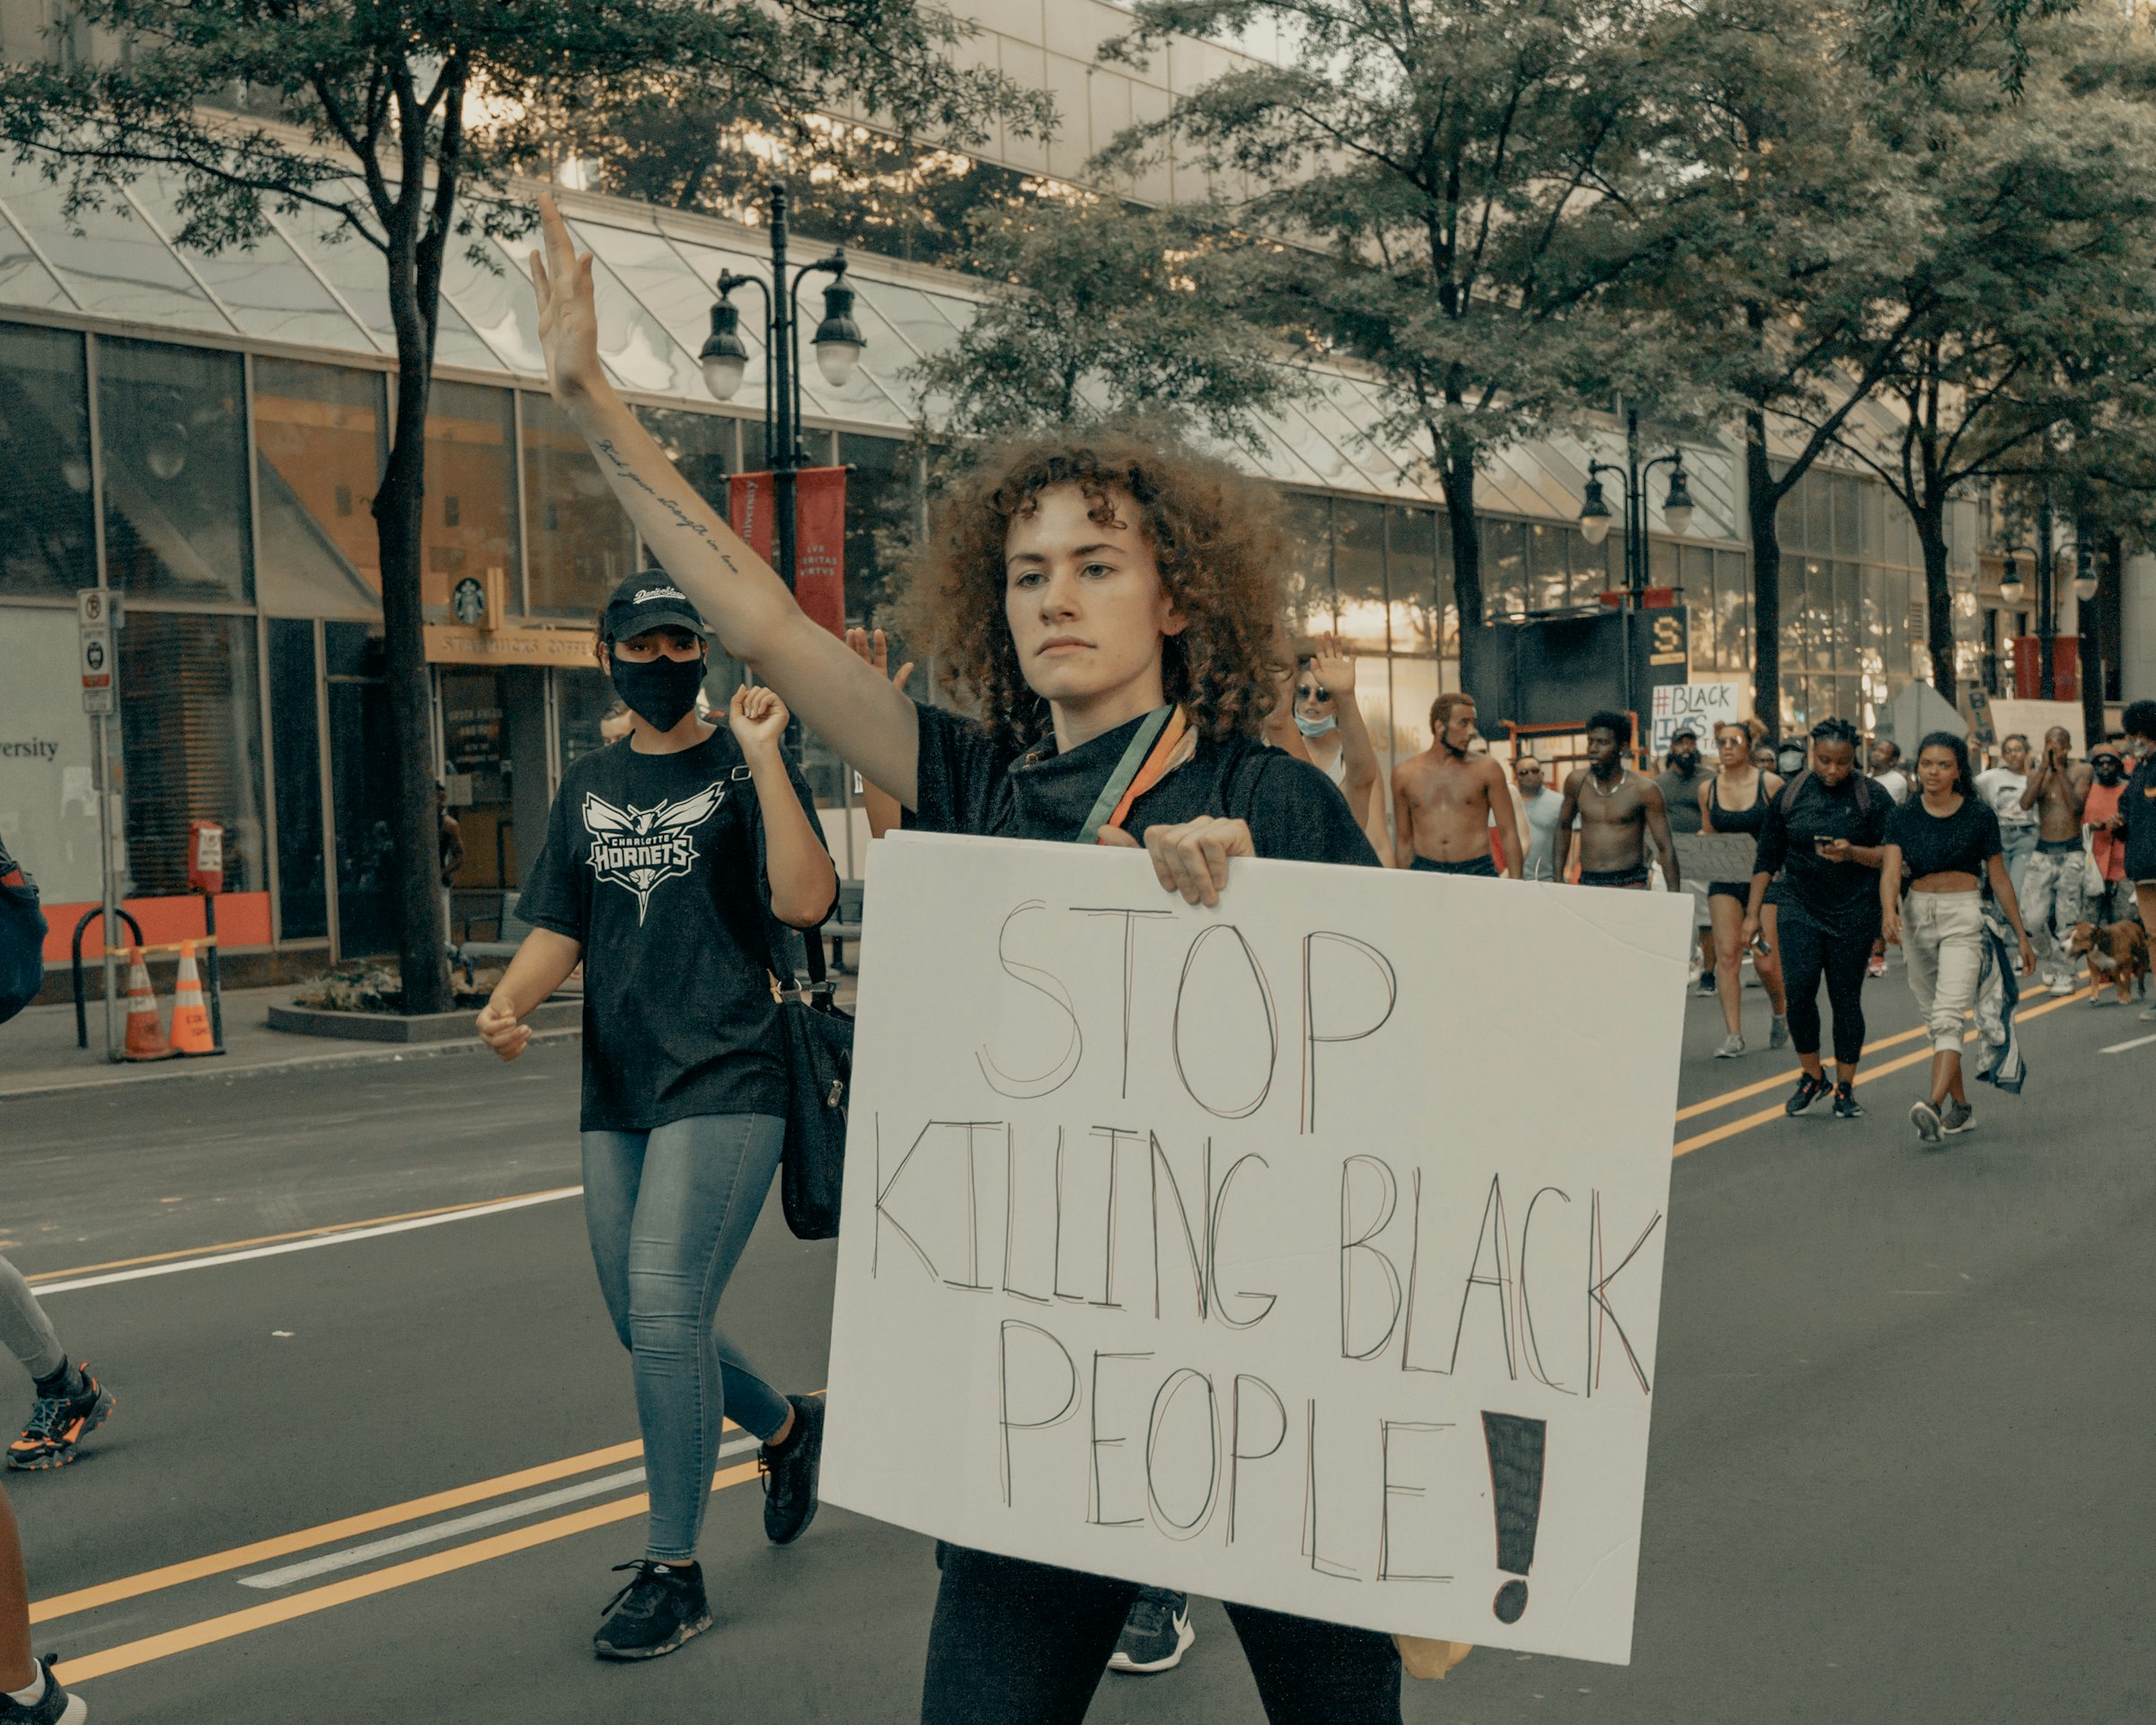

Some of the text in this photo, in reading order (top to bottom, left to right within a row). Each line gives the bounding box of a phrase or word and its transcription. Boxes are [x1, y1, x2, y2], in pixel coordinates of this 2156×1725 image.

[617, 473, 656, 495] your
[657, 496, 709, 536] strength
[706, 539, 719, 551] in
[720, 554, 738, 574] love
[743, 480, 759, 541] niversity
[1654, 616, 1682, 652] S
[1653, 686, 1730, 715] #BLACK
[0, 737, 58, 763] ersity
[1370, 724, 1420, 754] ASING
[595, 839, 690, 872] HORNETS
[612, 835, 670, 846] CHARLOTTE
[976, 898, 1397, 1135] STOP
[872, 1111, 1662, 1398] KILLING BLACK
[999, 1319, 1547, 1624] PEOPLE!
